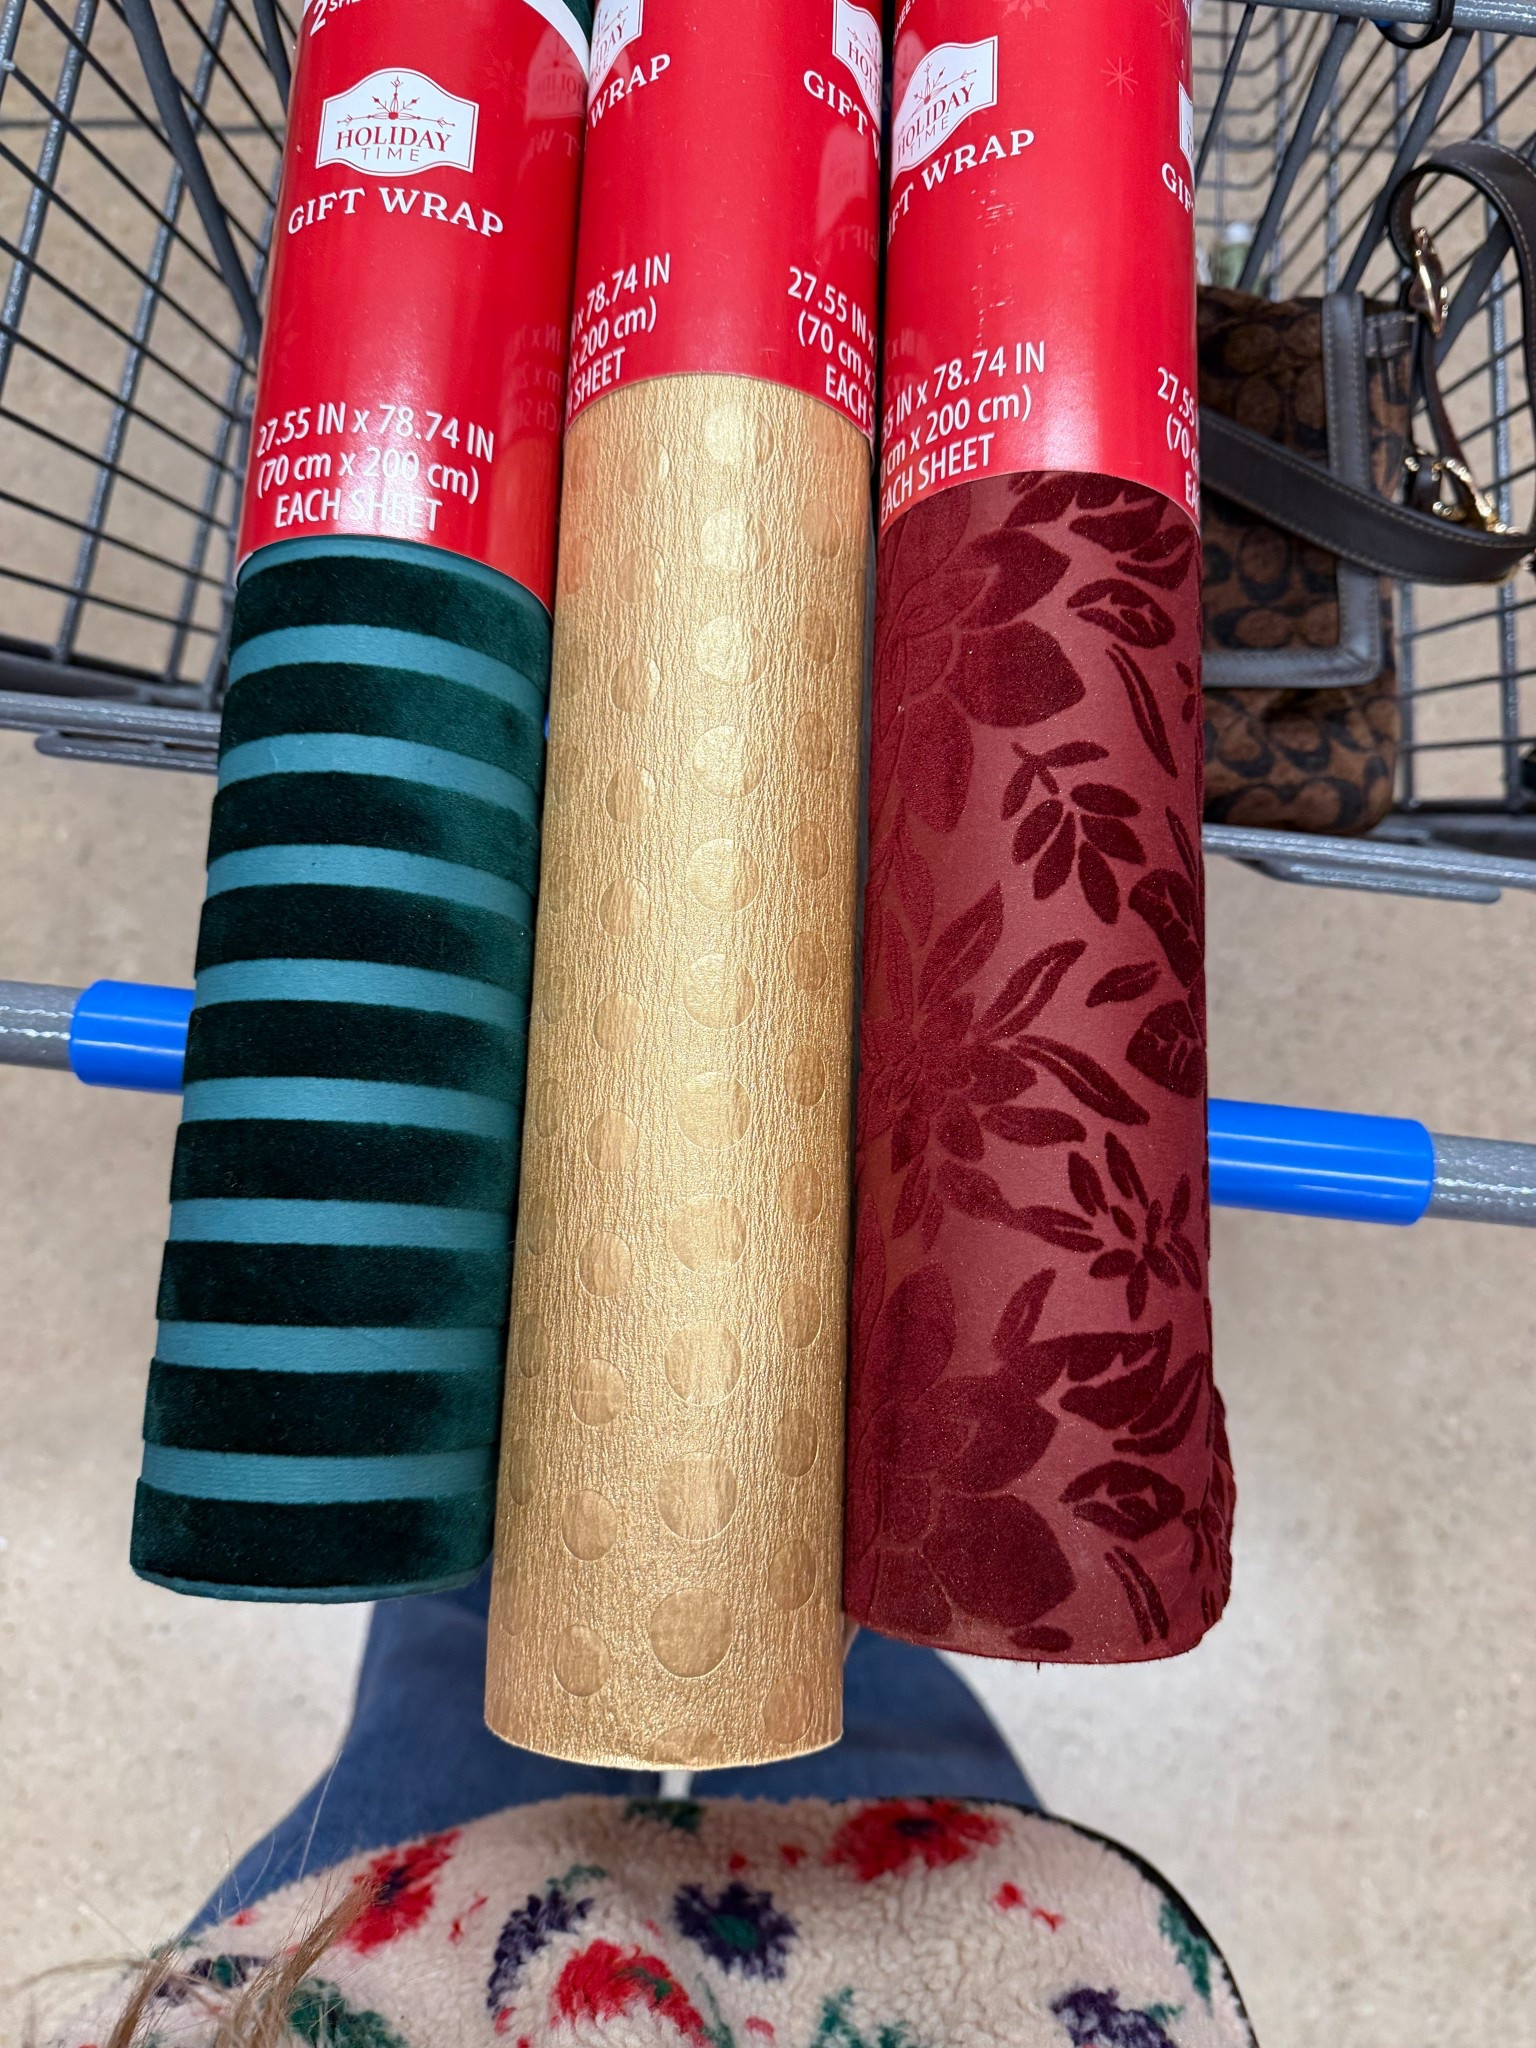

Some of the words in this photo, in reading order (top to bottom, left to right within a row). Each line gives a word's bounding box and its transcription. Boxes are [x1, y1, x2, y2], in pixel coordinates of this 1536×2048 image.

[591, 53, 671, 128] WRAP
[803, 70, 868, 136] GIFT
[336, 126, 452, 153] HOLIDAY
[361, 146, 420, 163] TIME
[898, 83, 975, 165] HOLIDAY
[910, 115, 949, 157] TIME
[921, 129, 1035, 191] WRAP
[288, 187, 365, 235] GIFT
[378, 187, 504, 238] WRAP
[577, 307, 585, 336] x
[587, 263, 638, 322] 78.74
[645, 253, 670, 289] IN
[787, 266, 847, 323] 27.55
[851, 302, 866, 344] IN
[579, 317, 609, 367] 200
[613, 296, 657, 339] cm)
[798, 309, 834, 354] (70
[838, 340, 862, 379] cm
[573, 346, 626, 411] SHEET
[826, 363, 867, 425] EACH
[896, 384, 912, 426] IN
[916, 379, 928, 410] x
[934, 346, 1006, 399] 78.74
[1015, 340, 1045, 374] IN
[1158, 366, 1195, 427] 27.55
[257, 407, 311, 458] 27.55
[317, 402, 346, 435] IN
[352, 408, 371, 433] x
[378, 403, 460, 449] 78.74
[466, 422, 494, 463] IN
[887, 438, 906, 475] cm
[910, 425, 921, 455] x
[926, 398, 970, 445] 200
[977, 384, 1032, 424] cm)
[1166, 413, 1191, 459] (70
[257, 453, 289, 499] (70
[293, 453, 331, 481] cm
[338, 452, 357, 477] x
[362, 445, 420, 482] 200
[427, 465, 480, 505] cm)
[881, 464, 913, 527] EACH
[918, 433, 994, 491] SHEET
[274, 487, 342, 529] EACH
[349, 489, 443, 531] SHEET
